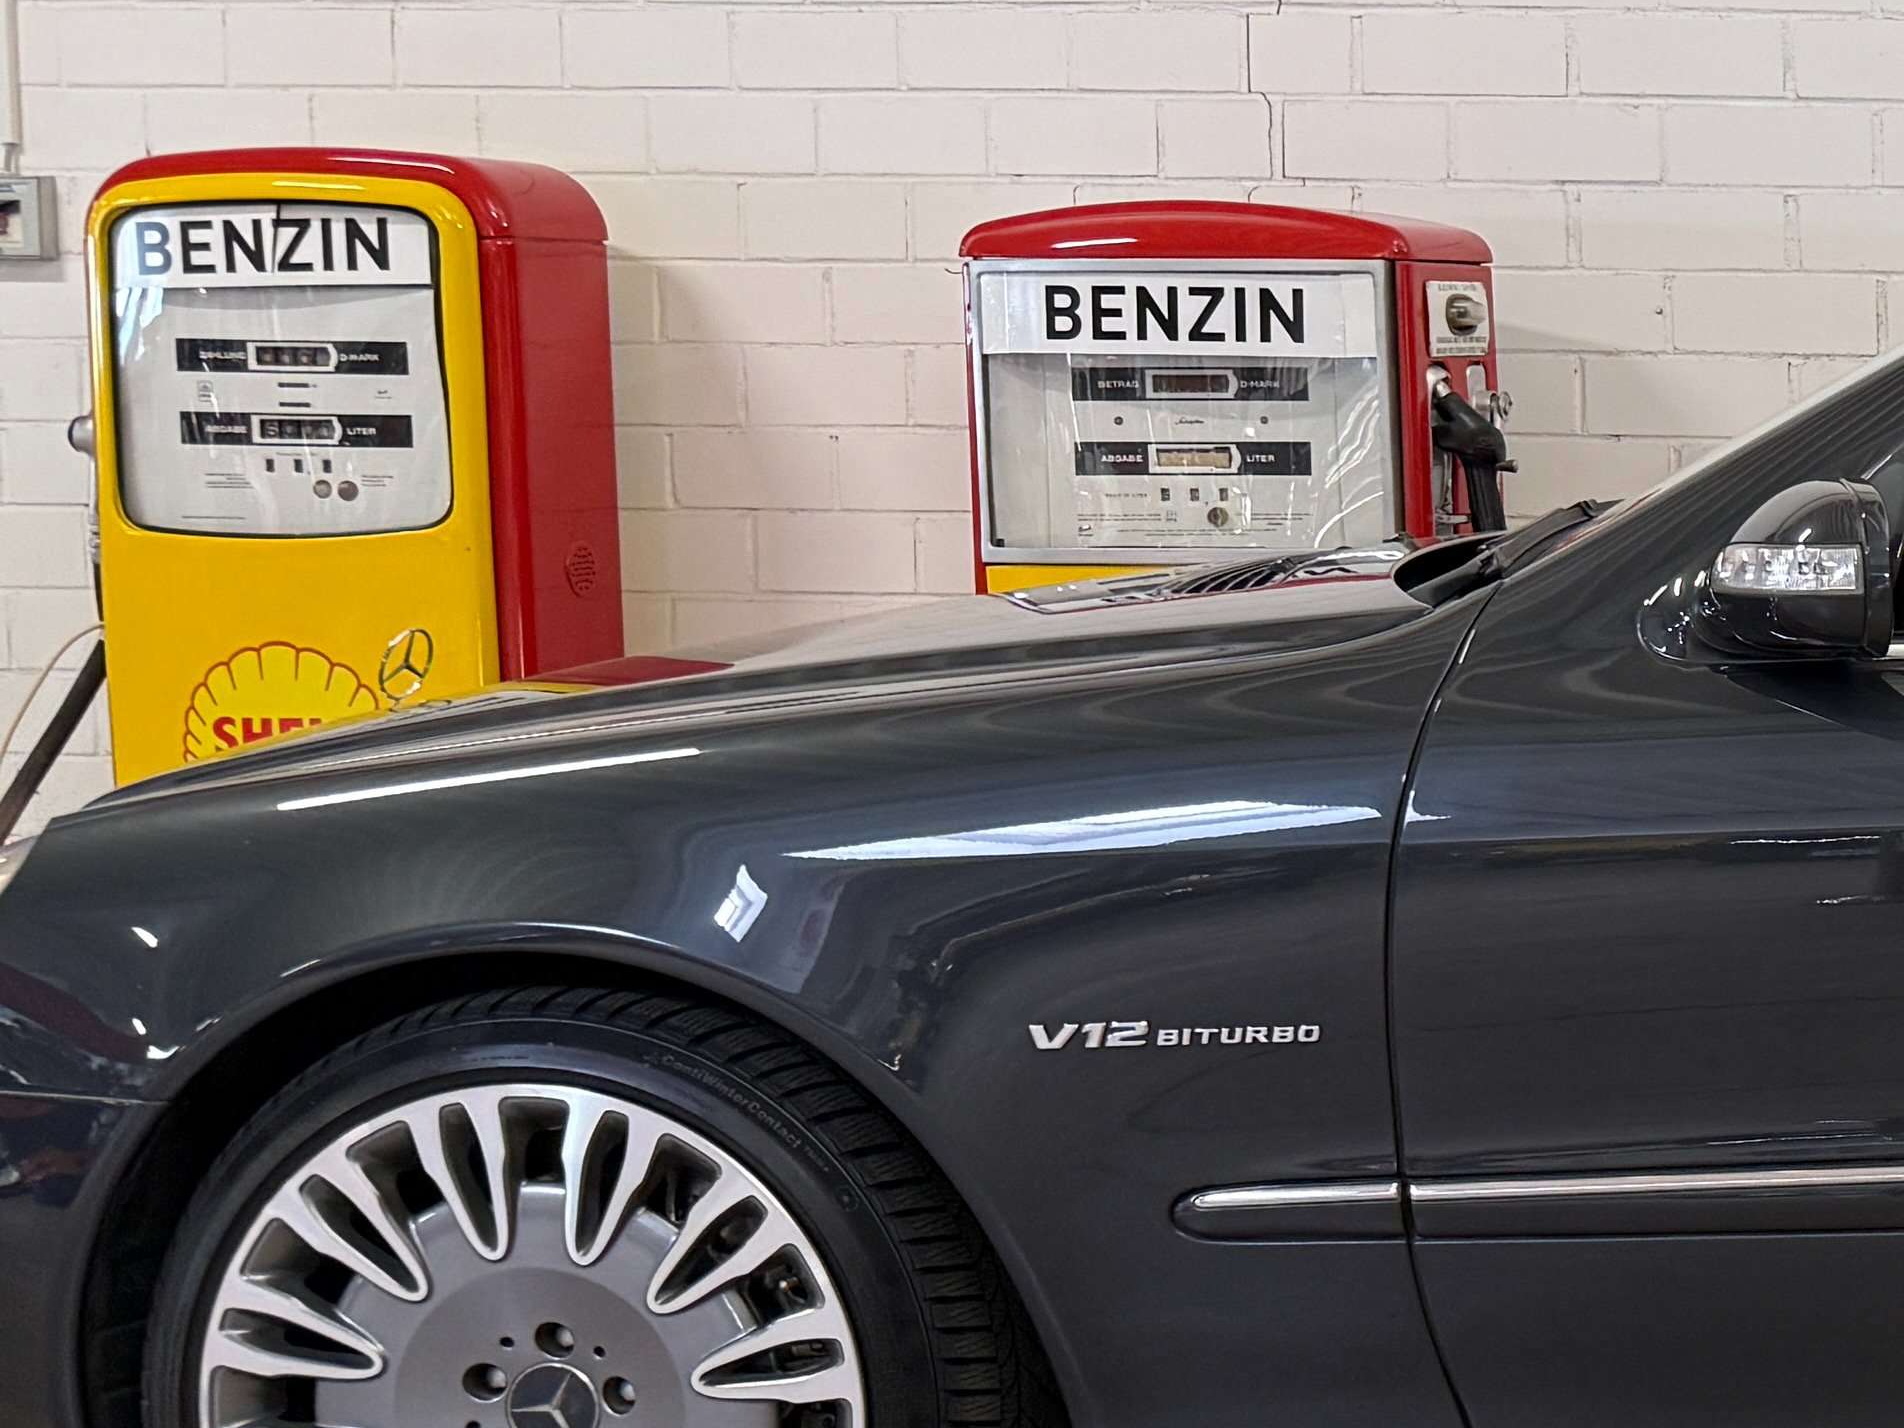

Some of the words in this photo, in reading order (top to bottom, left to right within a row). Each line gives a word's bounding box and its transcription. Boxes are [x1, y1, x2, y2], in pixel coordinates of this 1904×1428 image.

[135, 218, 391, 275] BENZIN
[1045, 285, 1304, 343] BENZIN
[1097, 380, 1140, 389] BETRAG
[1101, 454, 1143, 463] ABGABE
[1246, 454, 1275, 463] LITER
[1028, 1020, 1149, 1050] V12
[1156, 1024, 1321, 1046] BITURBO
